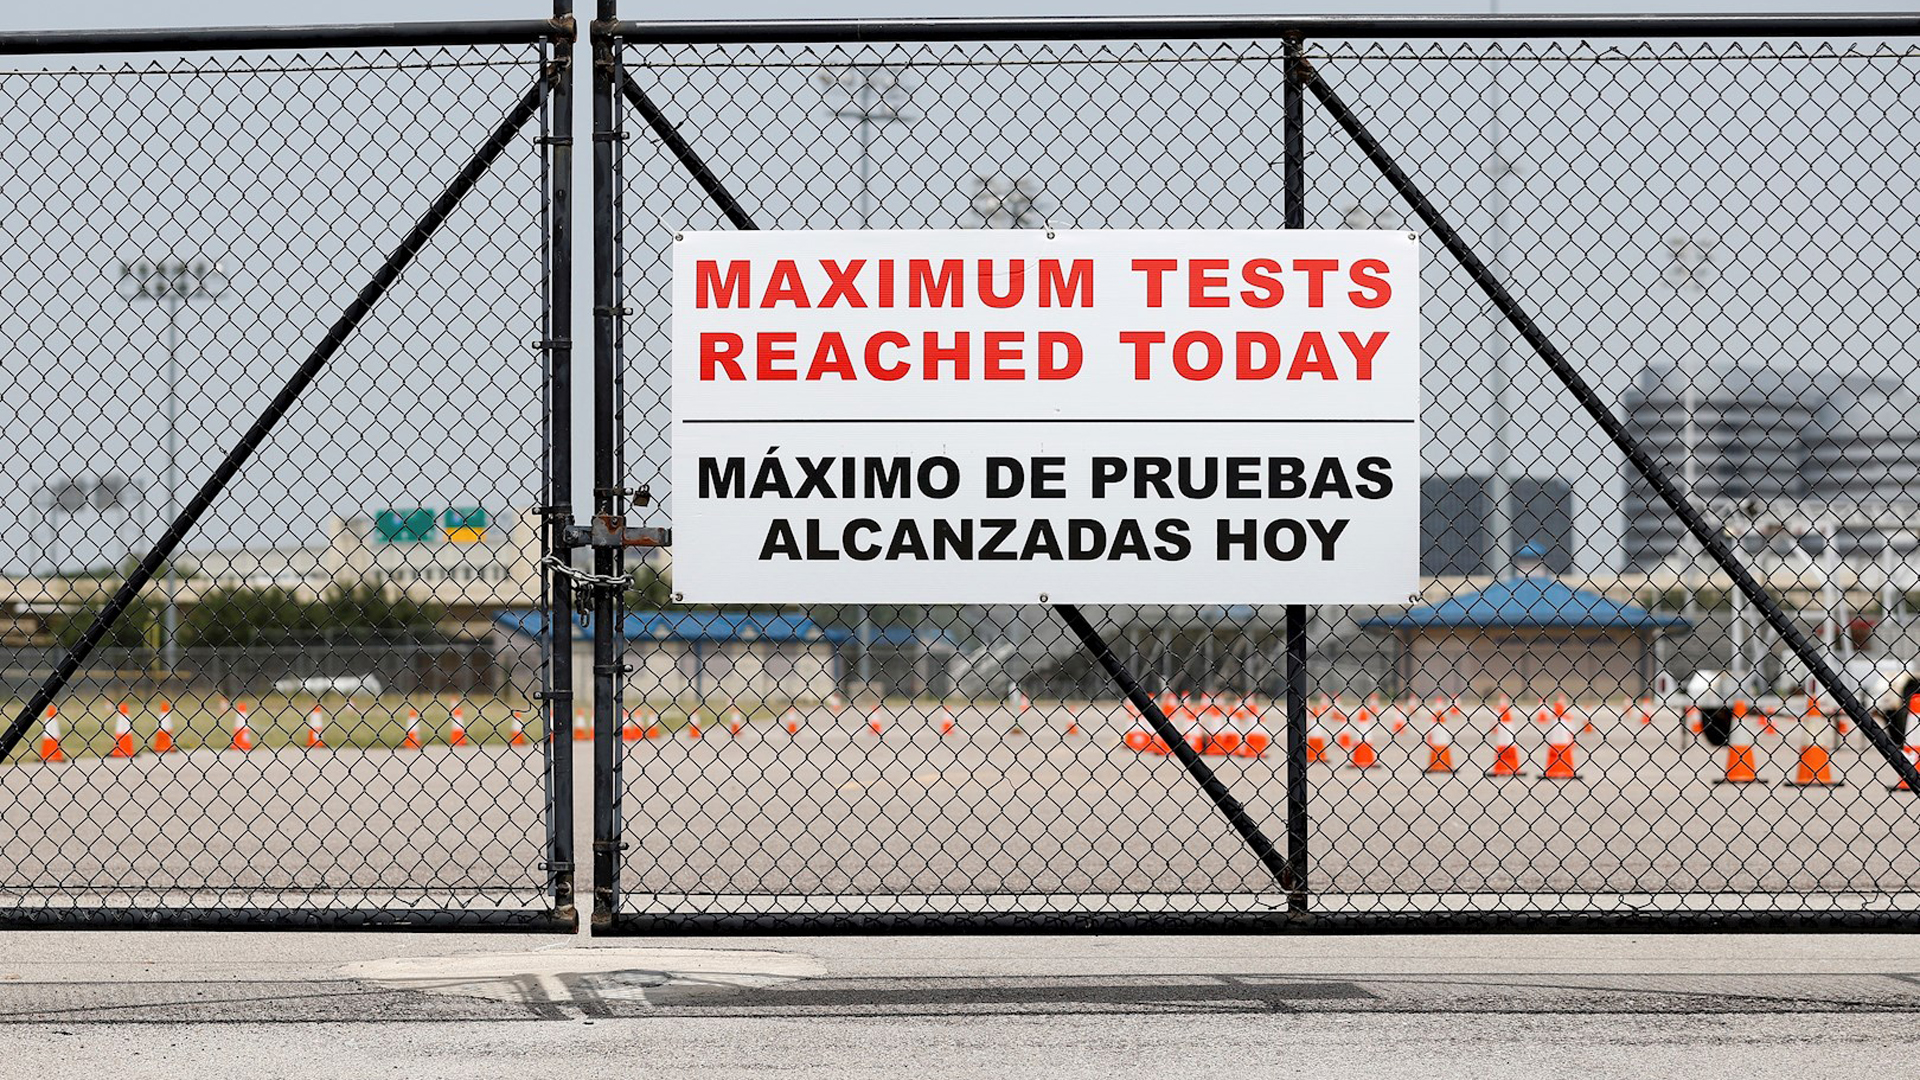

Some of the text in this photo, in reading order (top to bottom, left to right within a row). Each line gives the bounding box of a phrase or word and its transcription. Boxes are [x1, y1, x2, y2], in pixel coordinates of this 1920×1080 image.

[696, 259, 1391, 308] MAXIMUM TESTS
[700, 331, 1389, 381] REACHED TODAY
[699, 446, 1393, 499] MÁXIMO DE PRUEBAS
[759, 518, 1350, 561] ALCANZADAS HOY
